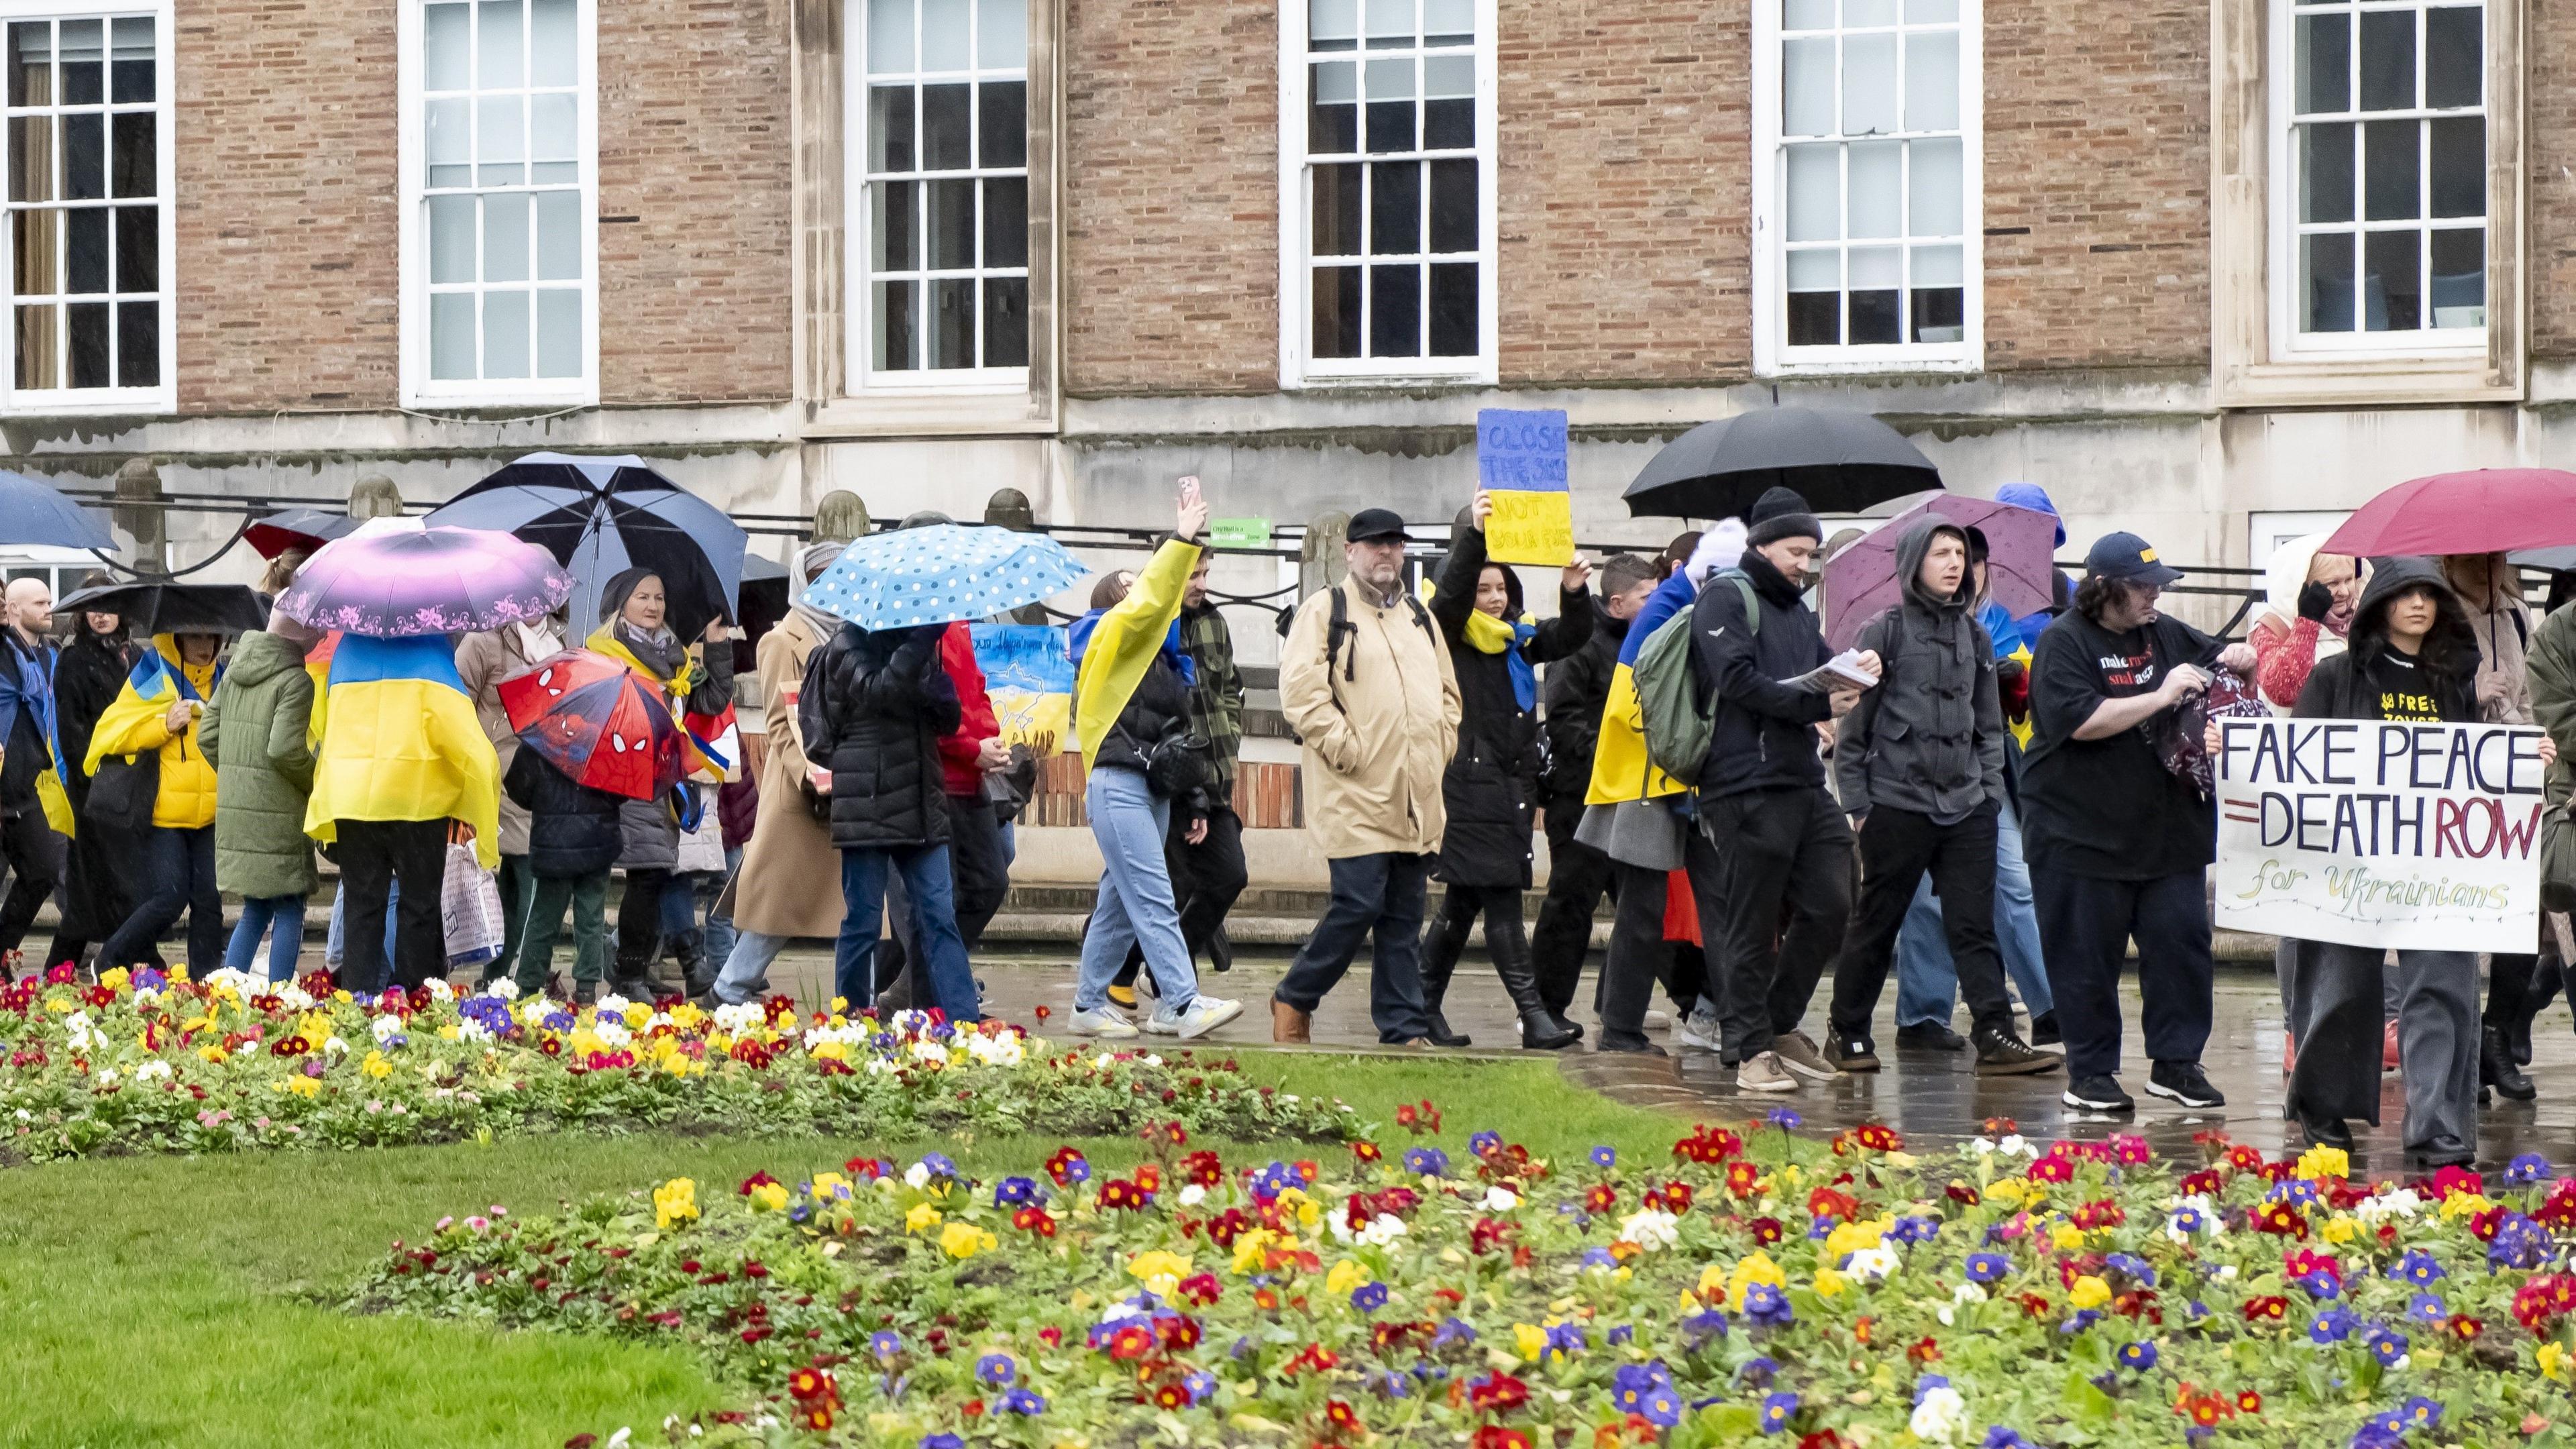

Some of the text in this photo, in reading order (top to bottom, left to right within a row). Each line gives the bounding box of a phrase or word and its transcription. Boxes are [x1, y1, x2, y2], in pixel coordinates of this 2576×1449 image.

[1489, 425, 1565, 451] CLOSE
[1493, 495, 1542, 521] NOT
[2221, 722, 2546, 795] FAKE PEACE
[2434, 797, 2543, 860] ROW
[2237, 859, 2509, 916] for Ukrainians
